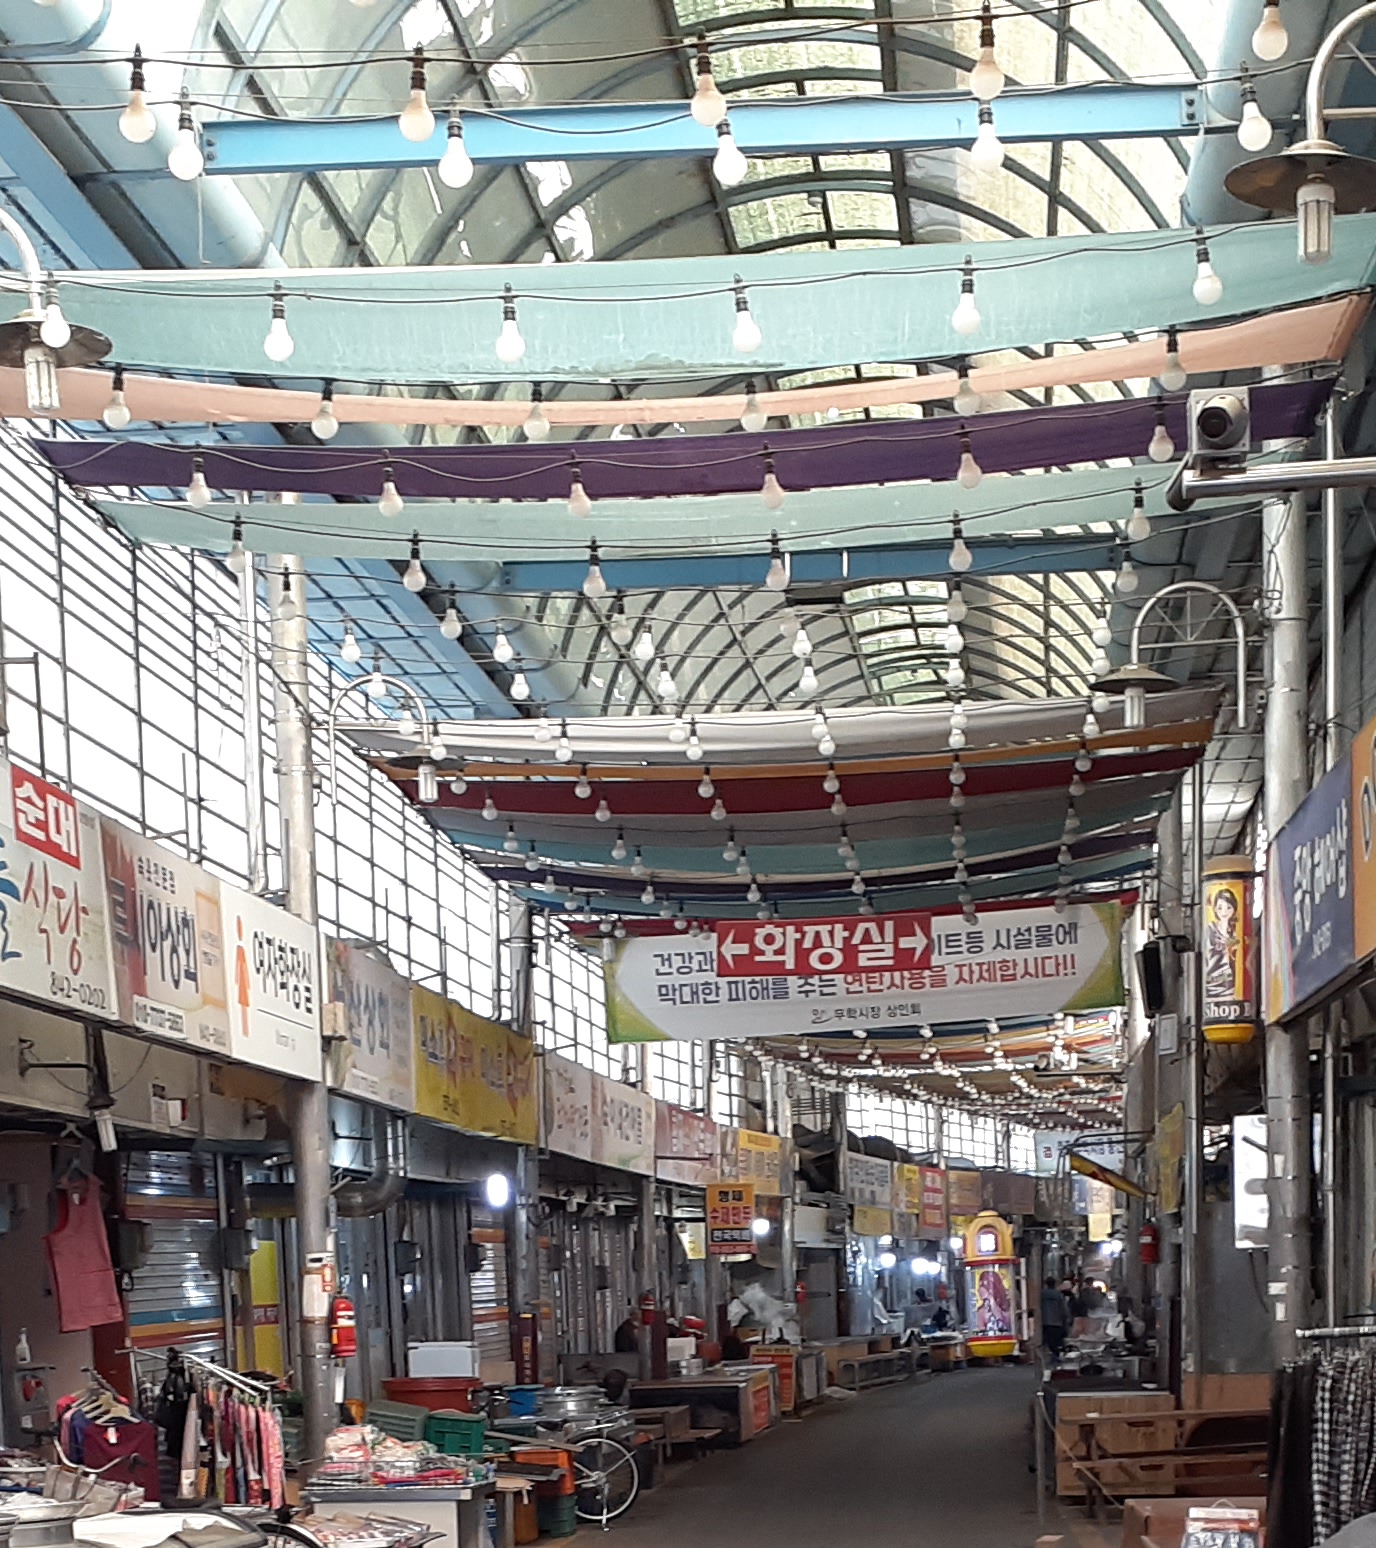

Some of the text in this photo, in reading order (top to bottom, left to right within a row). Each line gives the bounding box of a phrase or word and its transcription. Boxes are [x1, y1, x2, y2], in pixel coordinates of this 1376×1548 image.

[15, 780, 79, 858] 순대
[653, 950, 716, 977] 건강과
[993, 921, 1079, 951] 시설물에
[754, 921, 895, 971] 화장실
[657, 953, 1077, 1006] 막대한 피해를 주는 연탄사용을 자제합시다!!
